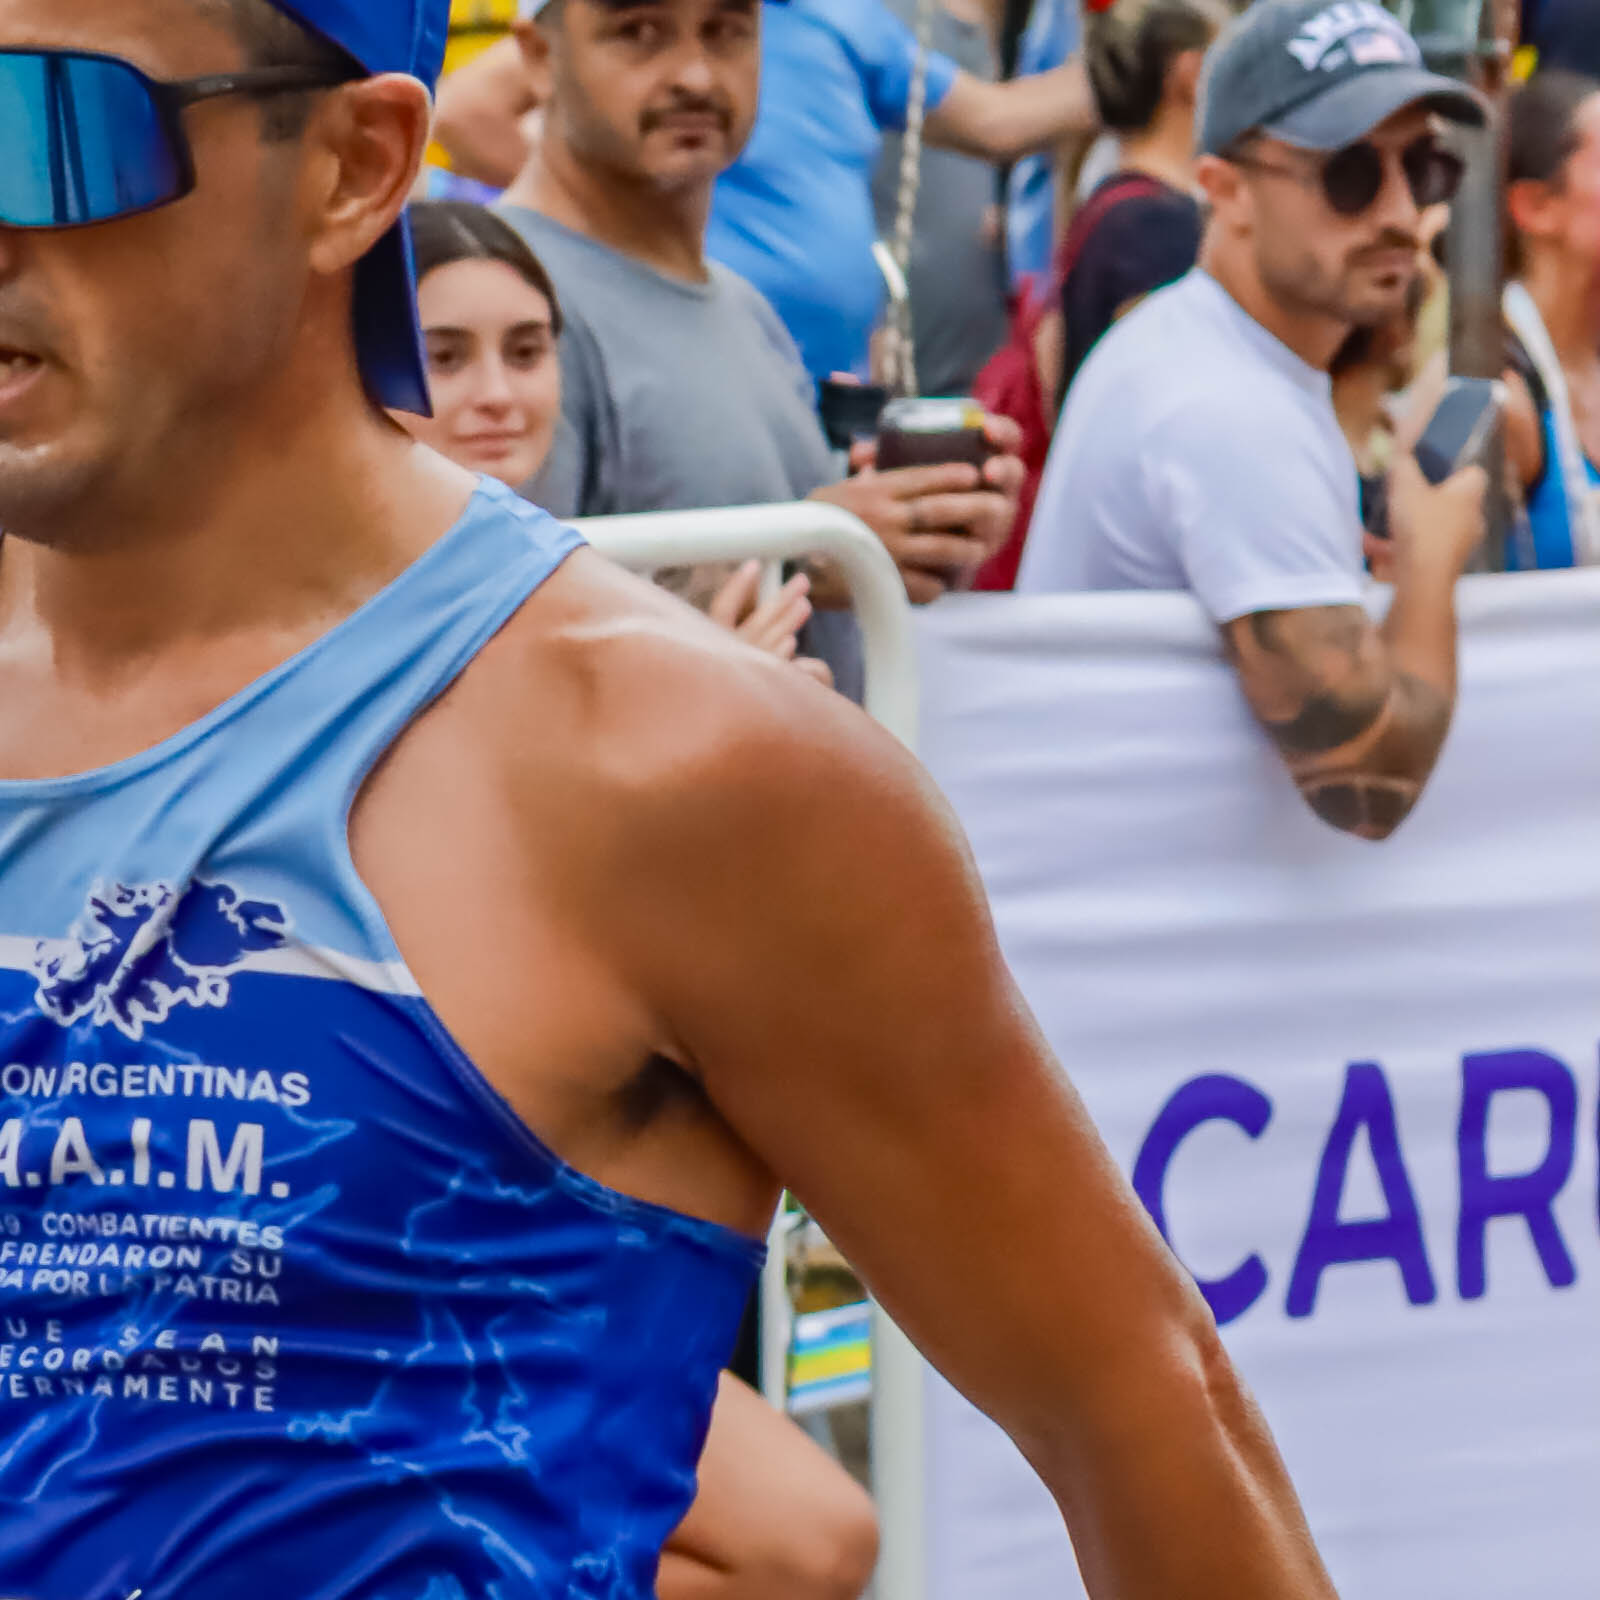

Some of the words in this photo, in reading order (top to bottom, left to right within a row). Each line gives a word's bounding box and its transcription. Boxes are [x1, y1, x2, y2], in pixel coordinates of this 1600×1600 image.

[1131, 1046, 1600, 1328] CAR
[41, 1211, 285, 1250] COMBATIENTES
[230, 1249, 282, 1279] SU
[31, 1268, 89, 1295] POR
[152, 1273, 280, 1307] PATRIA
[118, 1324, 279, 1357] SEAN
